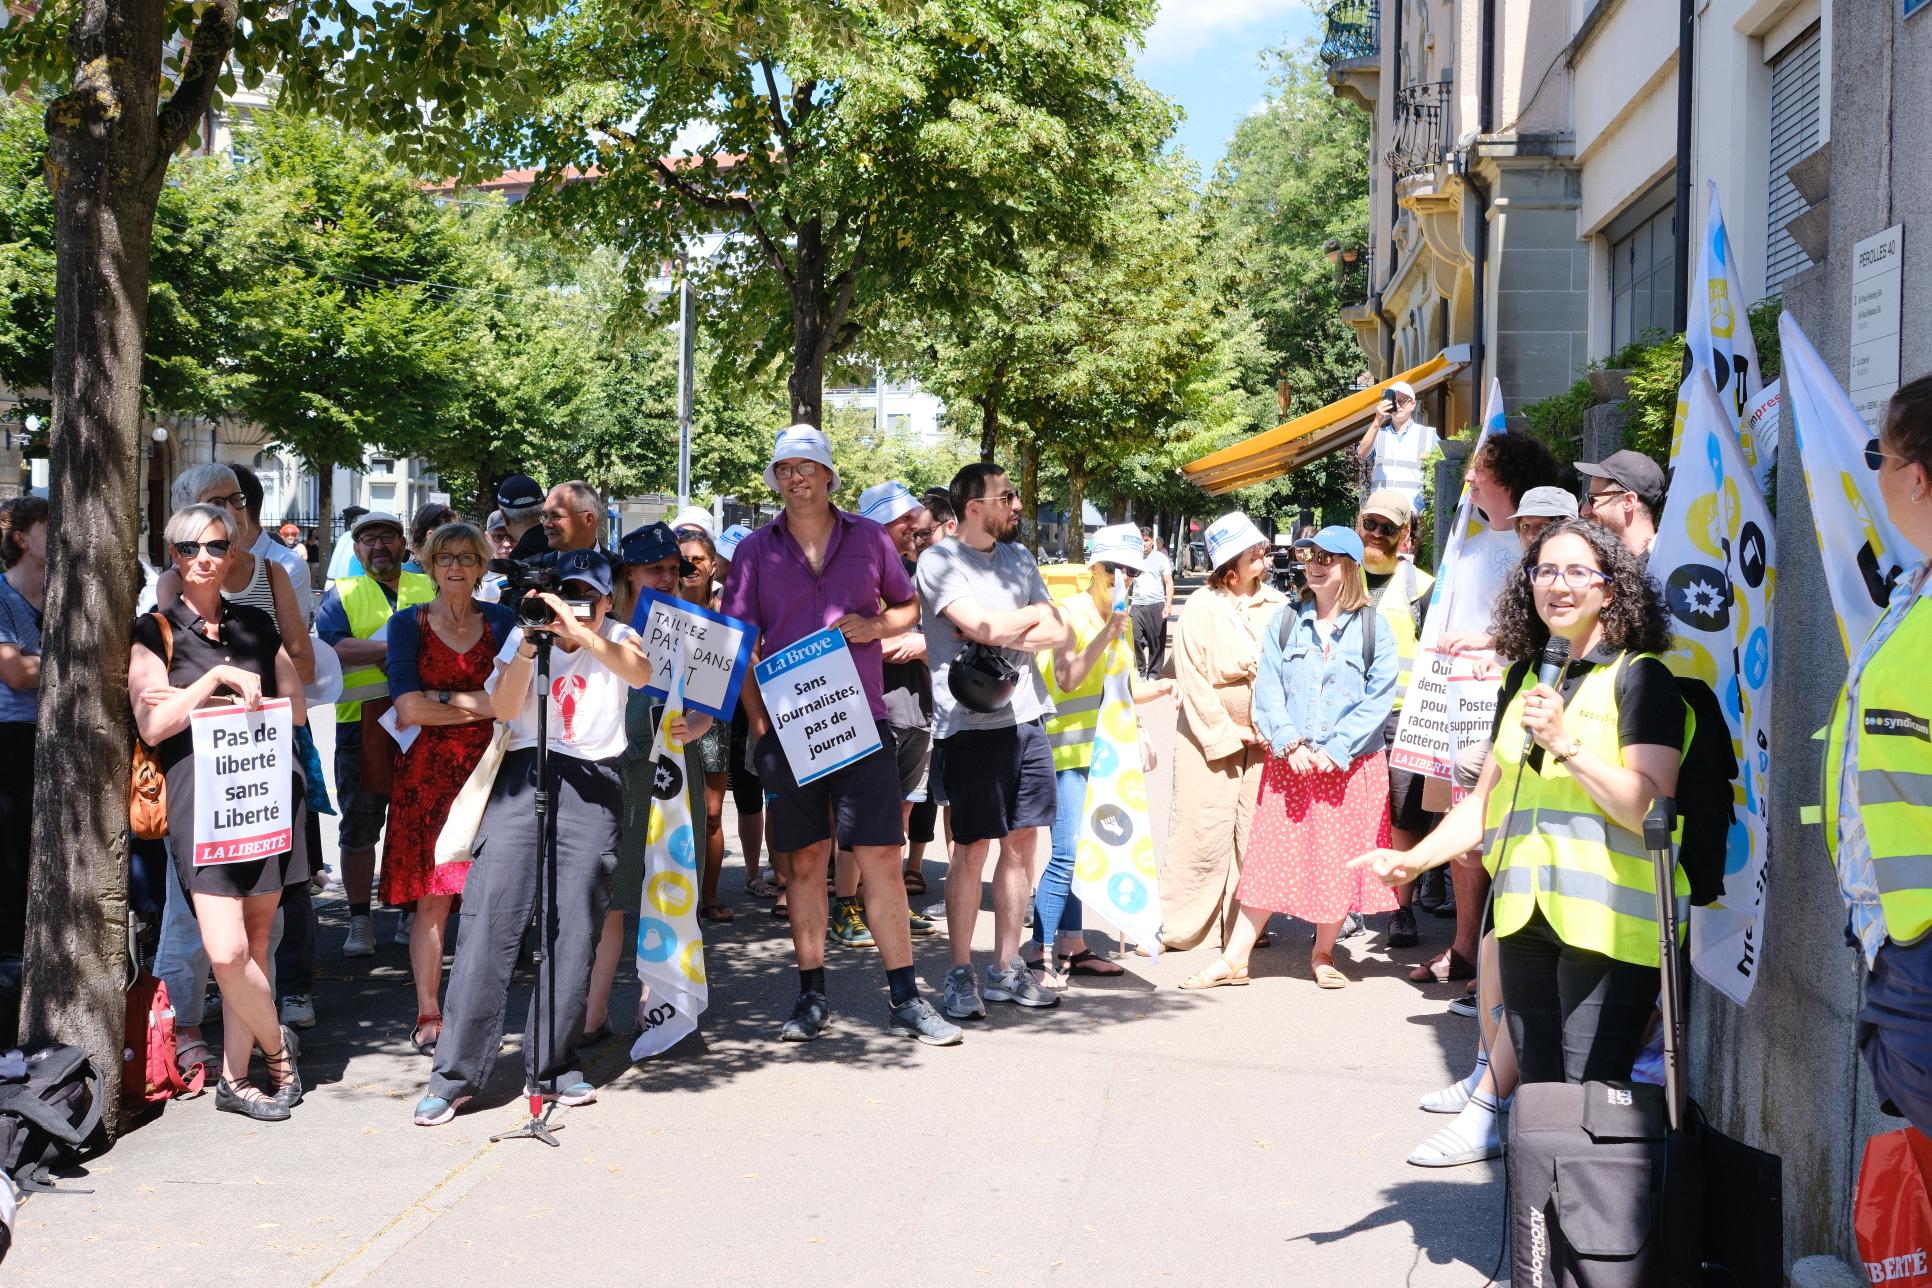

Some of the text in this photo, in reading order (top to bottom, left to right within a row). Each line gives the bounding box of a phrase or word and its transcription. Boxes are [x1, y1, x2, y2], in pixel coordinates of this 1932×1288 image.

[693, 648, 732, 672] DANS
[1431, 660, 1453, 675] Qui
[794, 675, 827, 696] Sans
[776, 685, 860, 729] journalistes,
[1459, 698, 1497, 712] Postes
[213, 723, 277, 748] Pas de
[804, 711, 848, 740] pas de
[1883, 717, 1929, 734] syndicom
[808, 726, 857, 761] journal
[1400, 728, 1450, 752] Gottéron
[215, 749, 276, 775] liberté
[1395, 753, 1451, 775] LA LIBERT
[225, 781, 269, 801] sans
[214, 800, 279, 829] Liberté
[202, 833, 287, 860] LA LIBERTÉ
